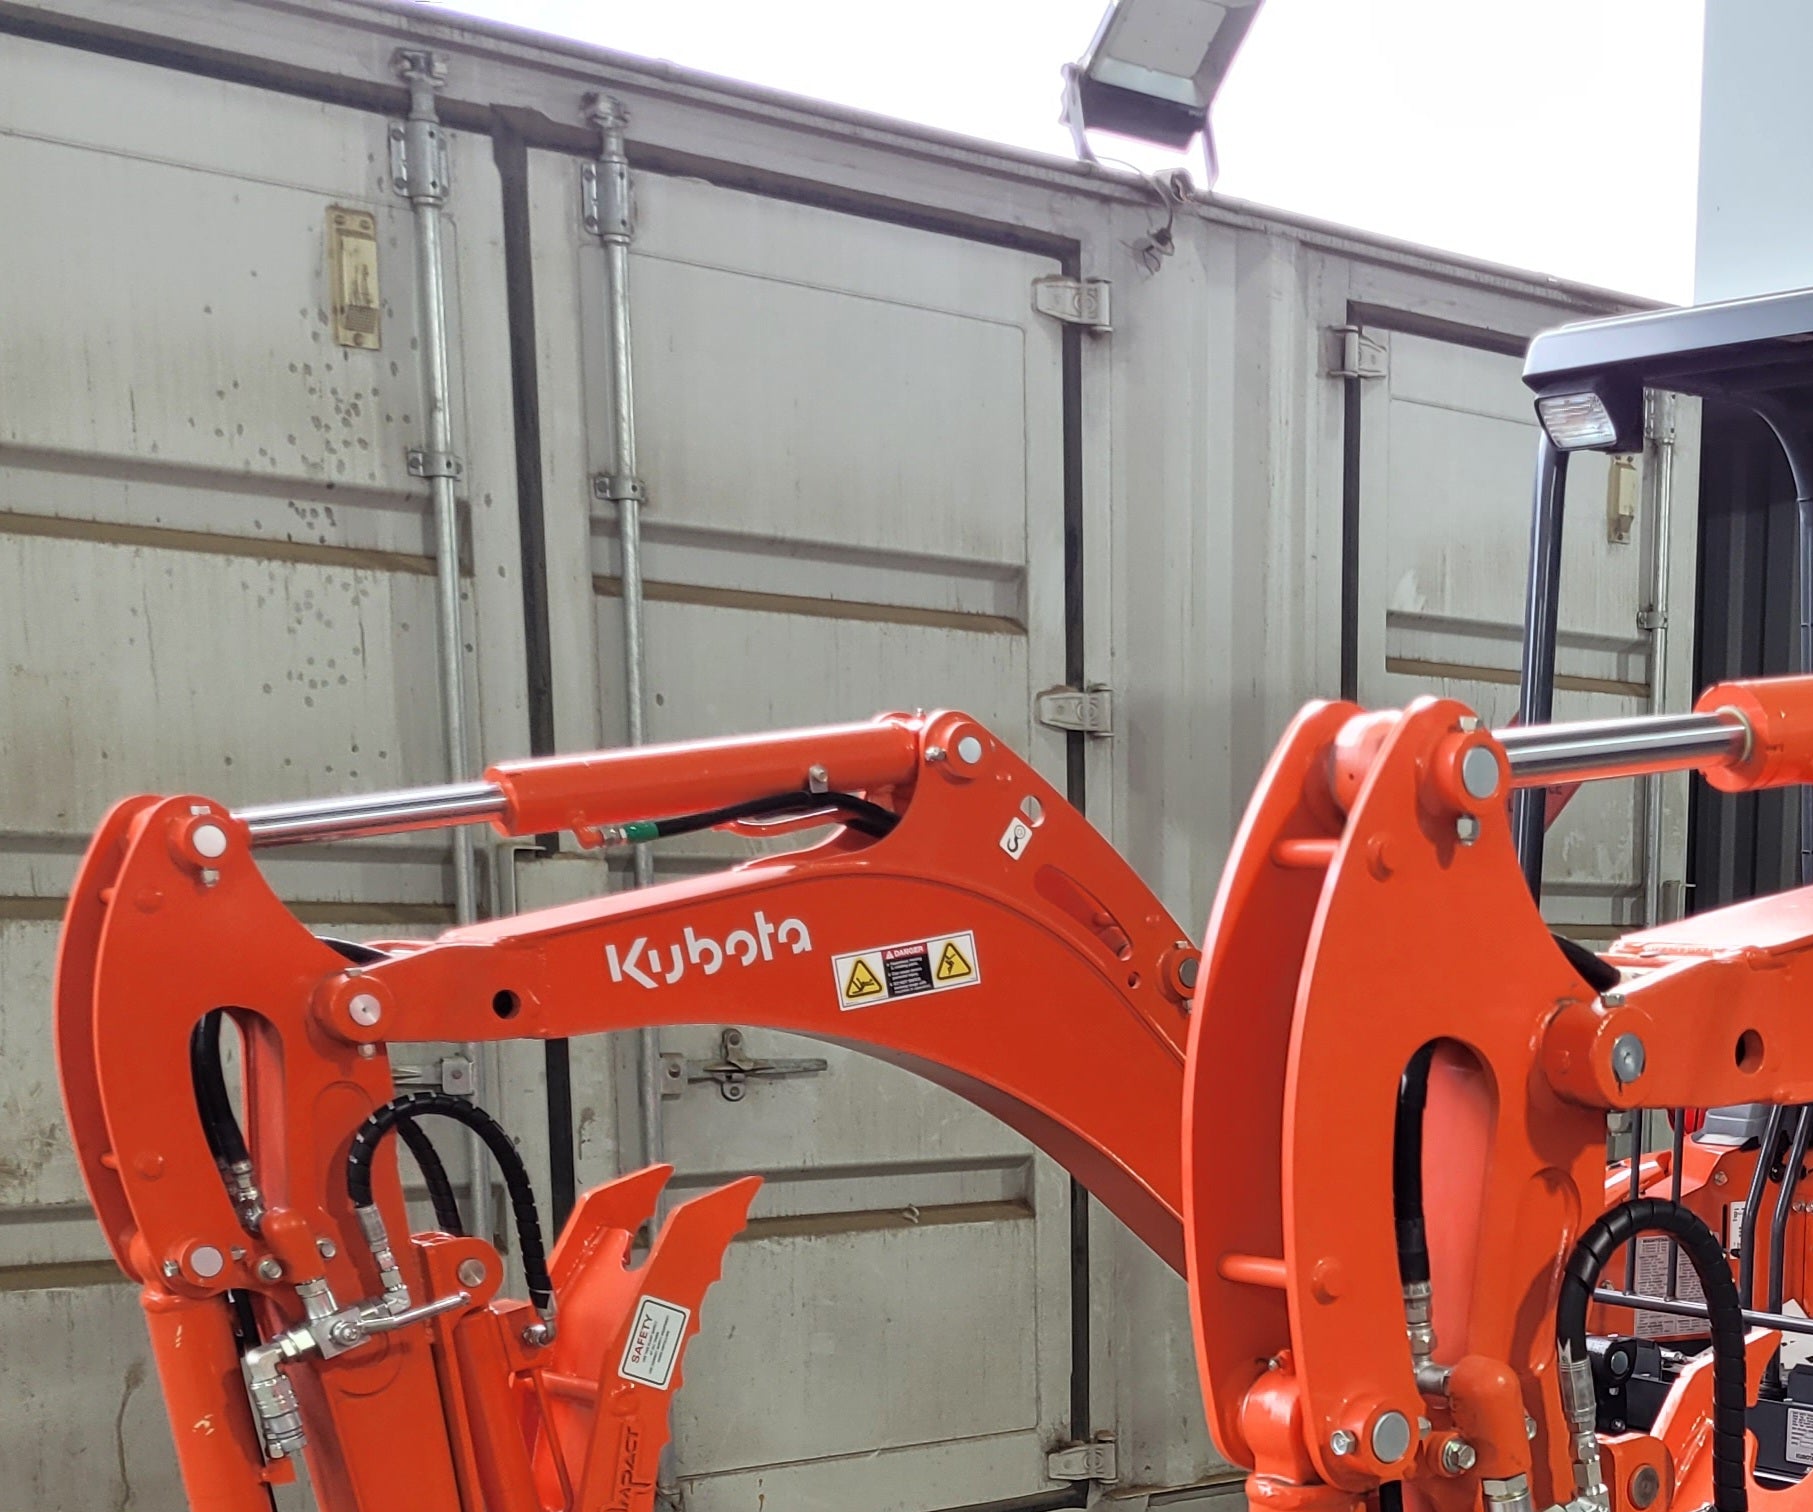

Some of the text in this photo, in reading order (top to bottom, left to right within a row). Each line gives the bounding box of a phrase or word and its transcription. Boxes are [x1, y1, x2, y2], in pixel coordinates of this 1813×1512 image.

[605, 911, 812, 990] Kubota
[893, 945, 924, 957] DANGER
[632, 1314, 653, 1363] SAFETY
